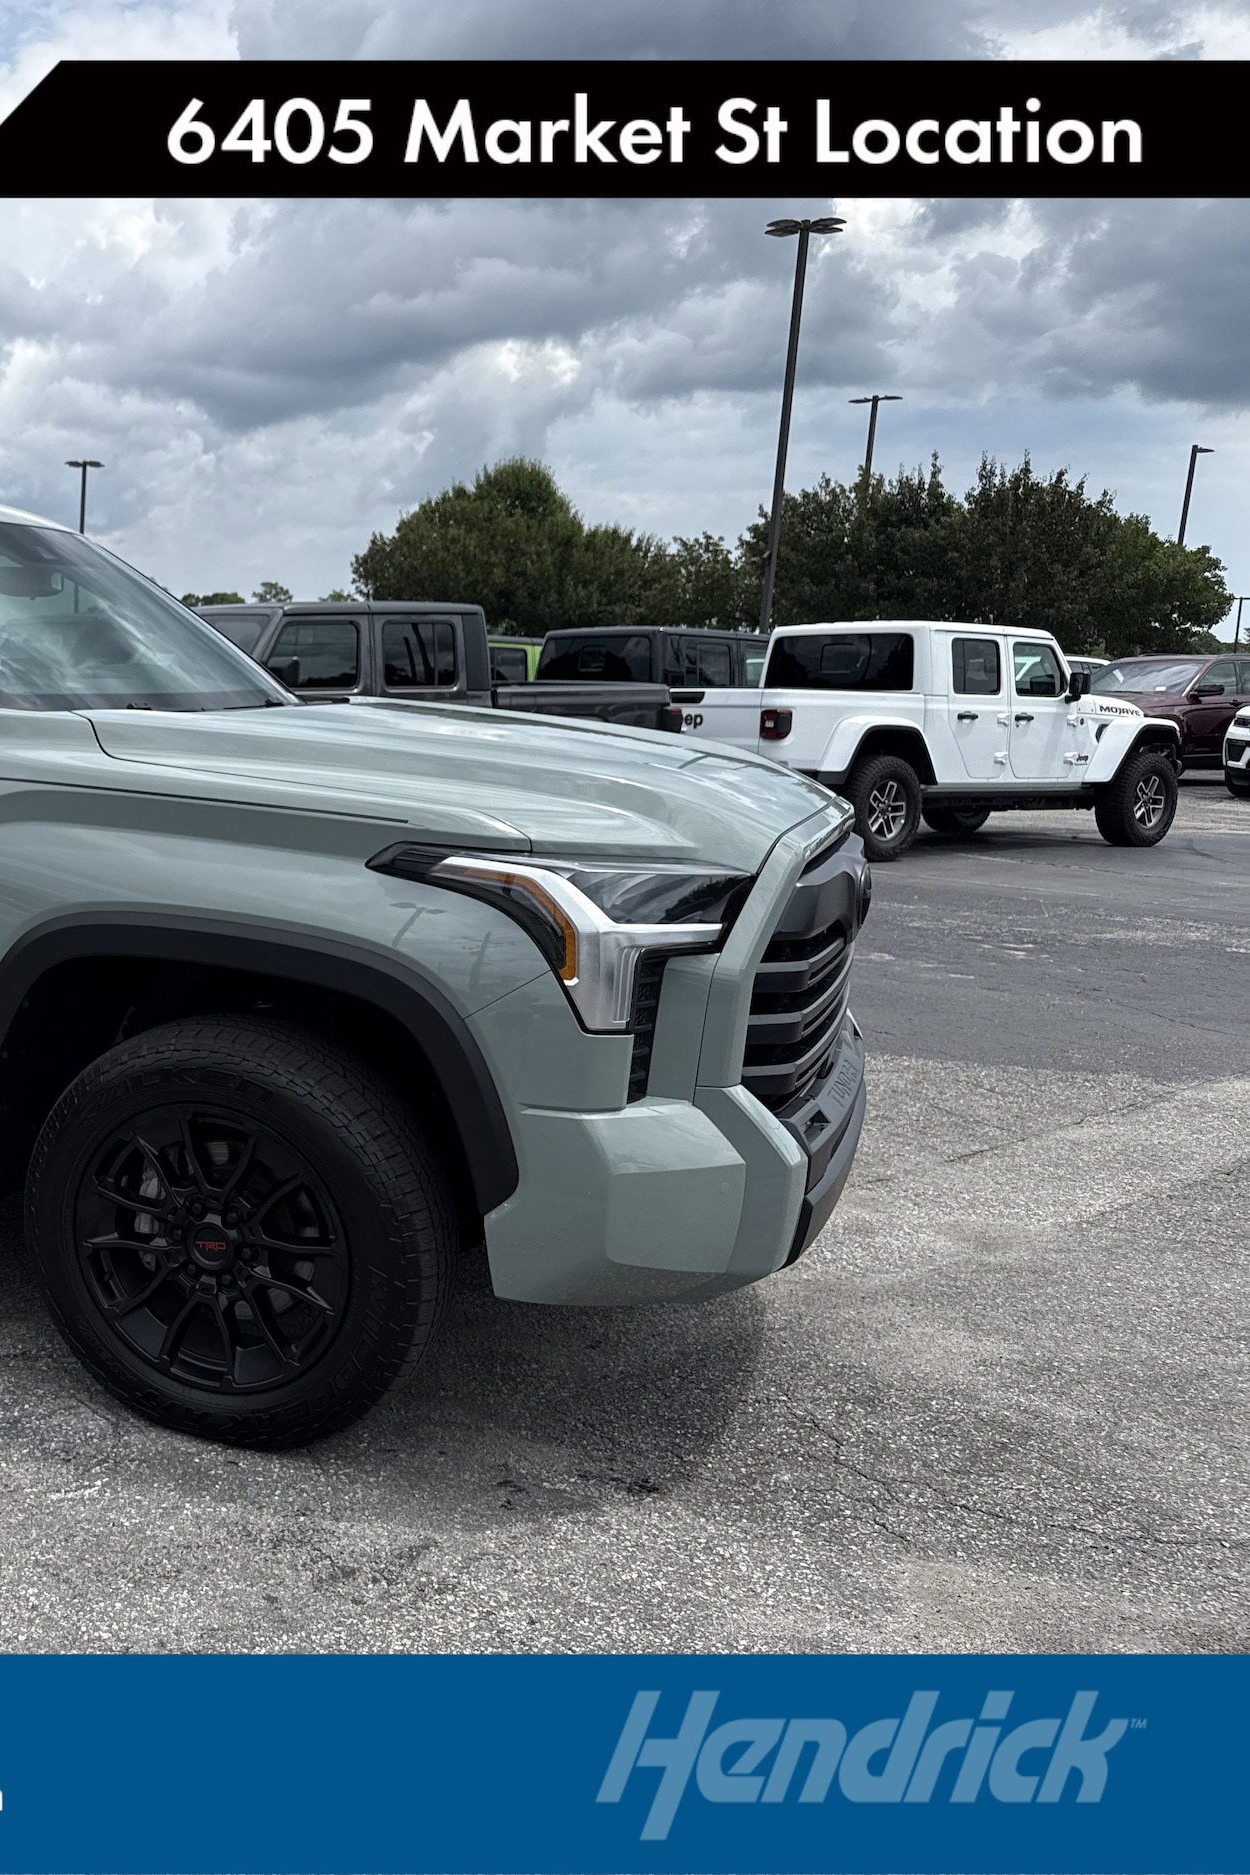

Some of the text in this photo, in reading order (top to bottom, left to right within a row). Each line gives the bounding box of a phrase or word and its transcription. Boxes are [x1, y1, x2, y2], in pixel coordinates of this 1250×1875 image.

[1099, 705, 1141, 717] MOJAVE
[684, 713, 704, 729] ep
[195, 1241, 227, 1252] TRD
